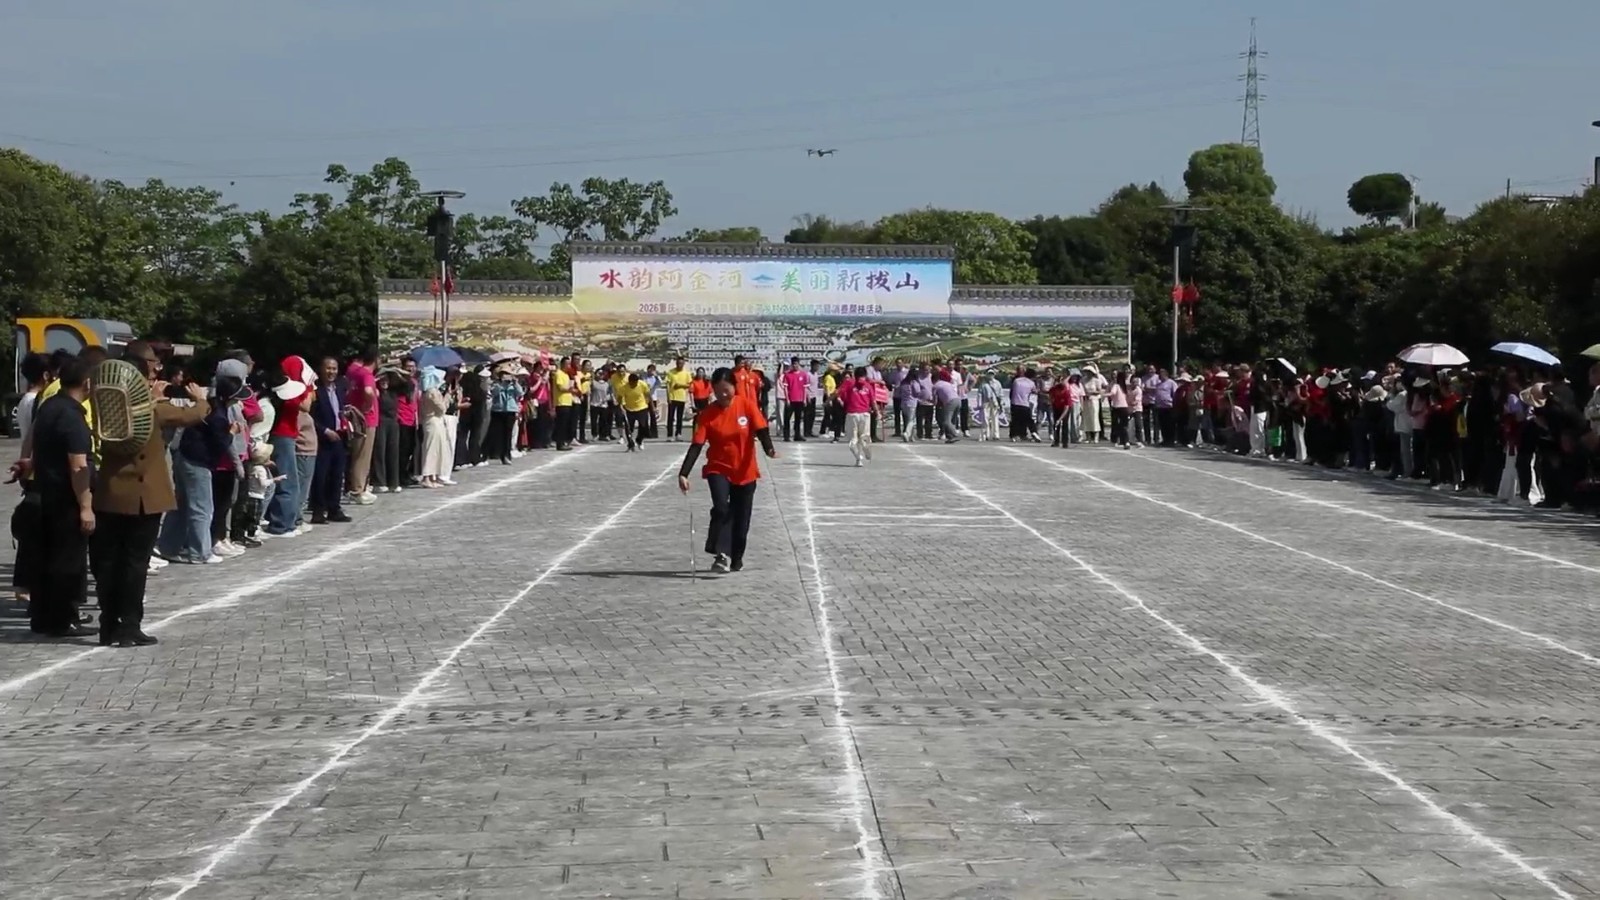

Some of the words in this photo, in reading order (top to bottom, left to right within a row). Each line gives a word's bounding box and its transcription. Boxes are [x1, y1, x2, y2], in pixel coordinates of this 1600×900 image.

[599, 268, 742, 290] 水韵阿金河
[780, 268, 920, 293] 美丽新拔山
